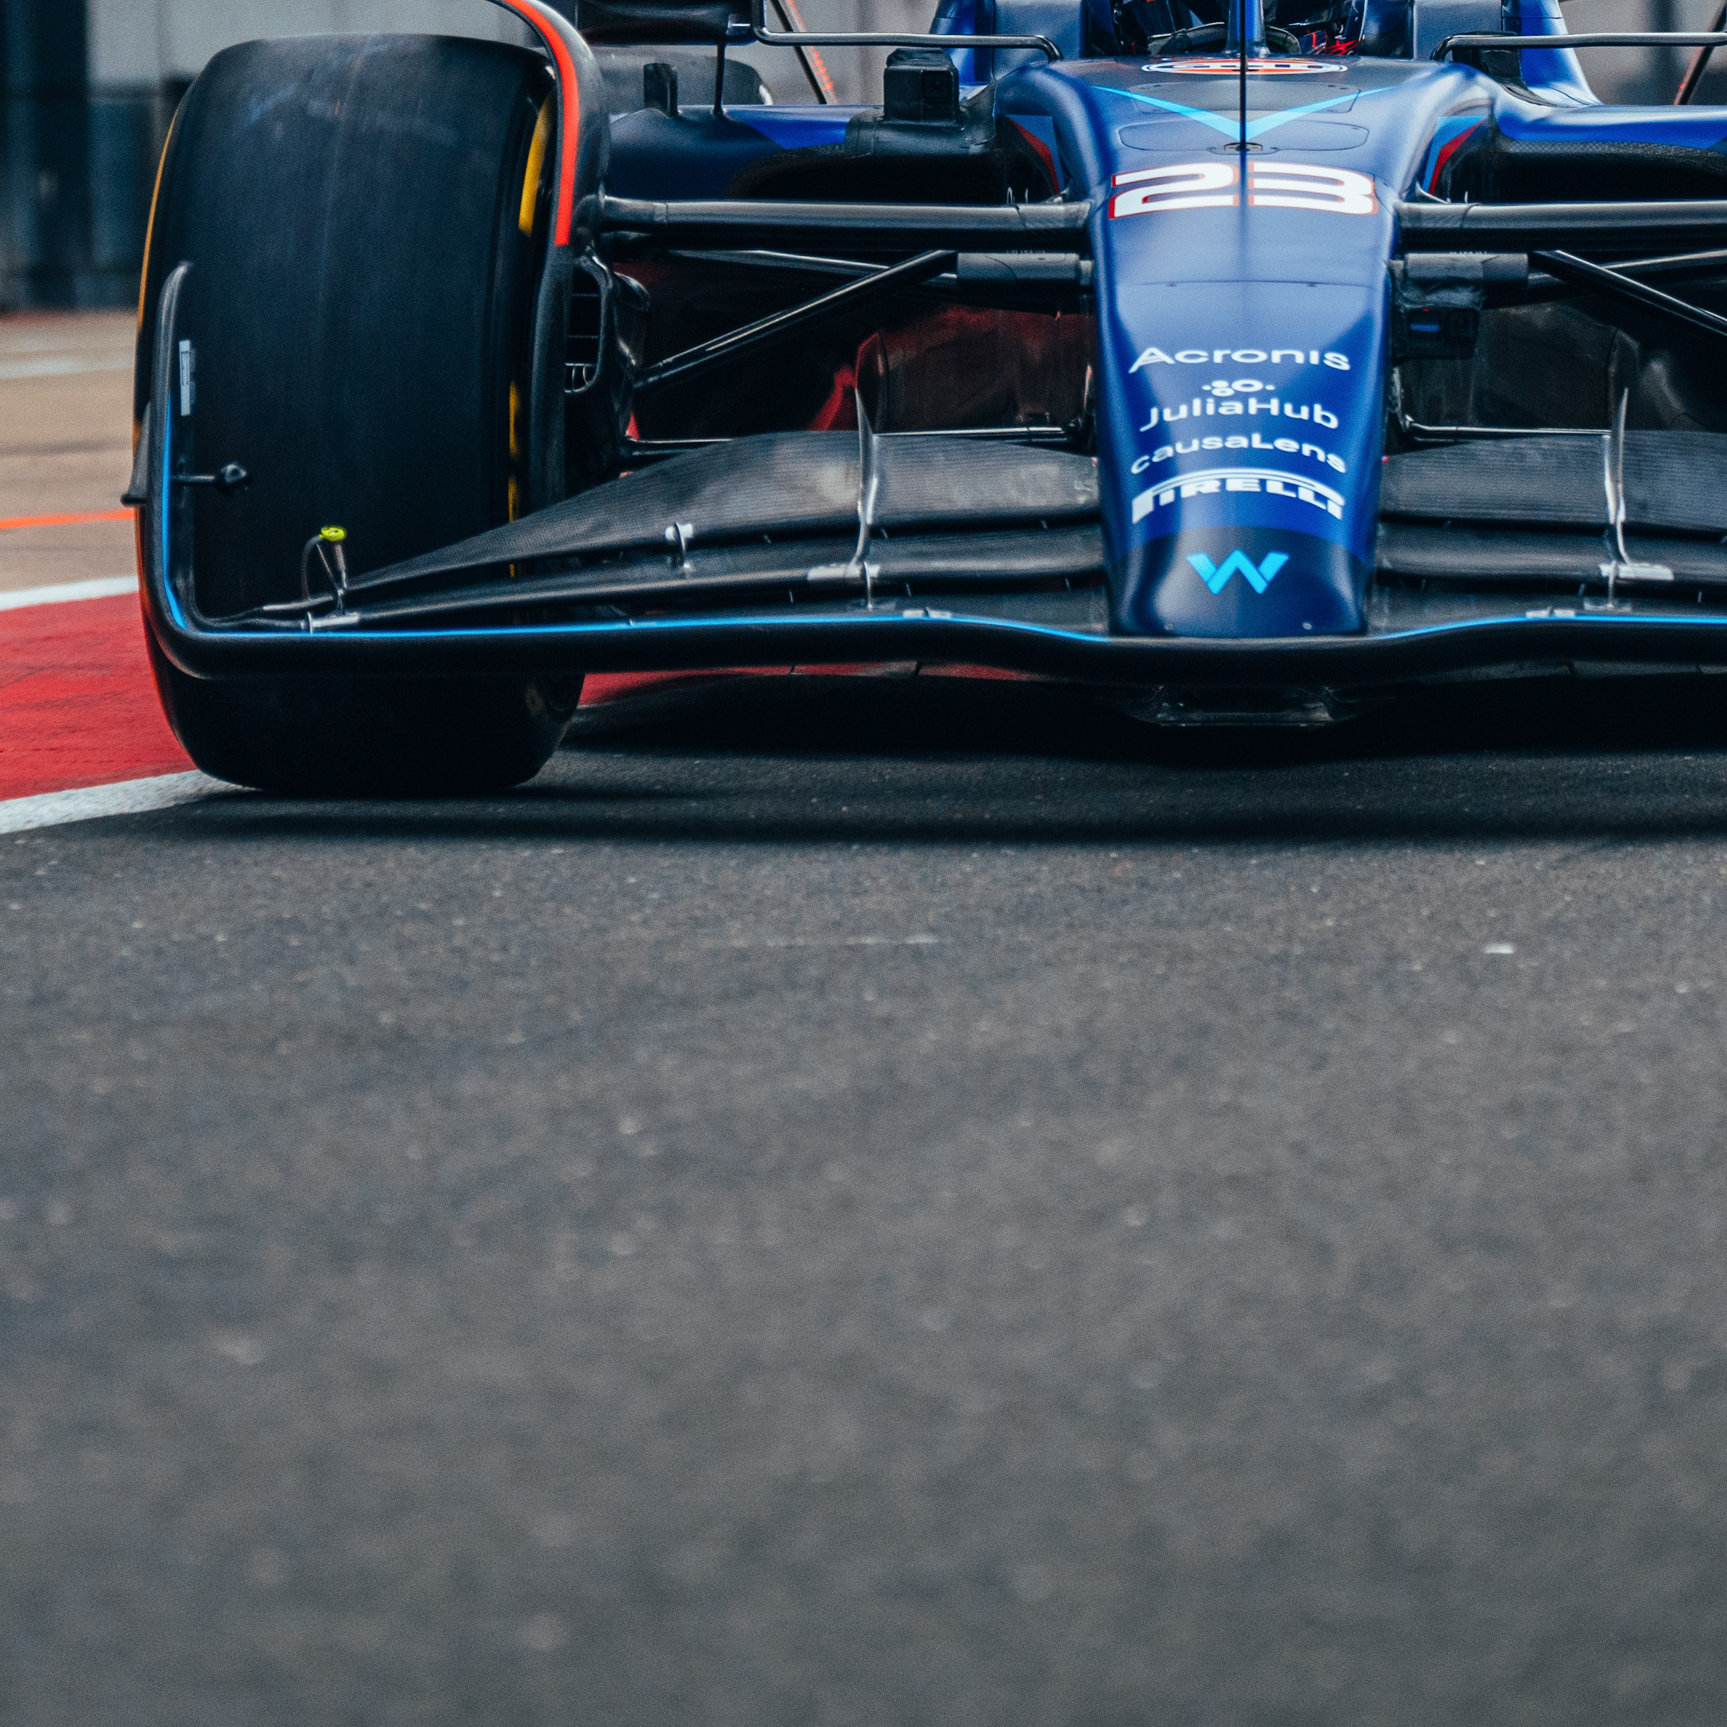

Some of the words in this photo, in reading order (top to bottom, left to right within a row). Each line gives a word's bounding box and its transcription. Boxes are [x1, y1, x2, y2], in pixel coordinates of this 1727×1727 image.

[1108, 160, 1380, 220] 23
[1139, 397, 1340, 433] JuliaHub
[1130, 433, 1347, 475] causaLens
[1131, 468, 1346, 525] PIRELLI
